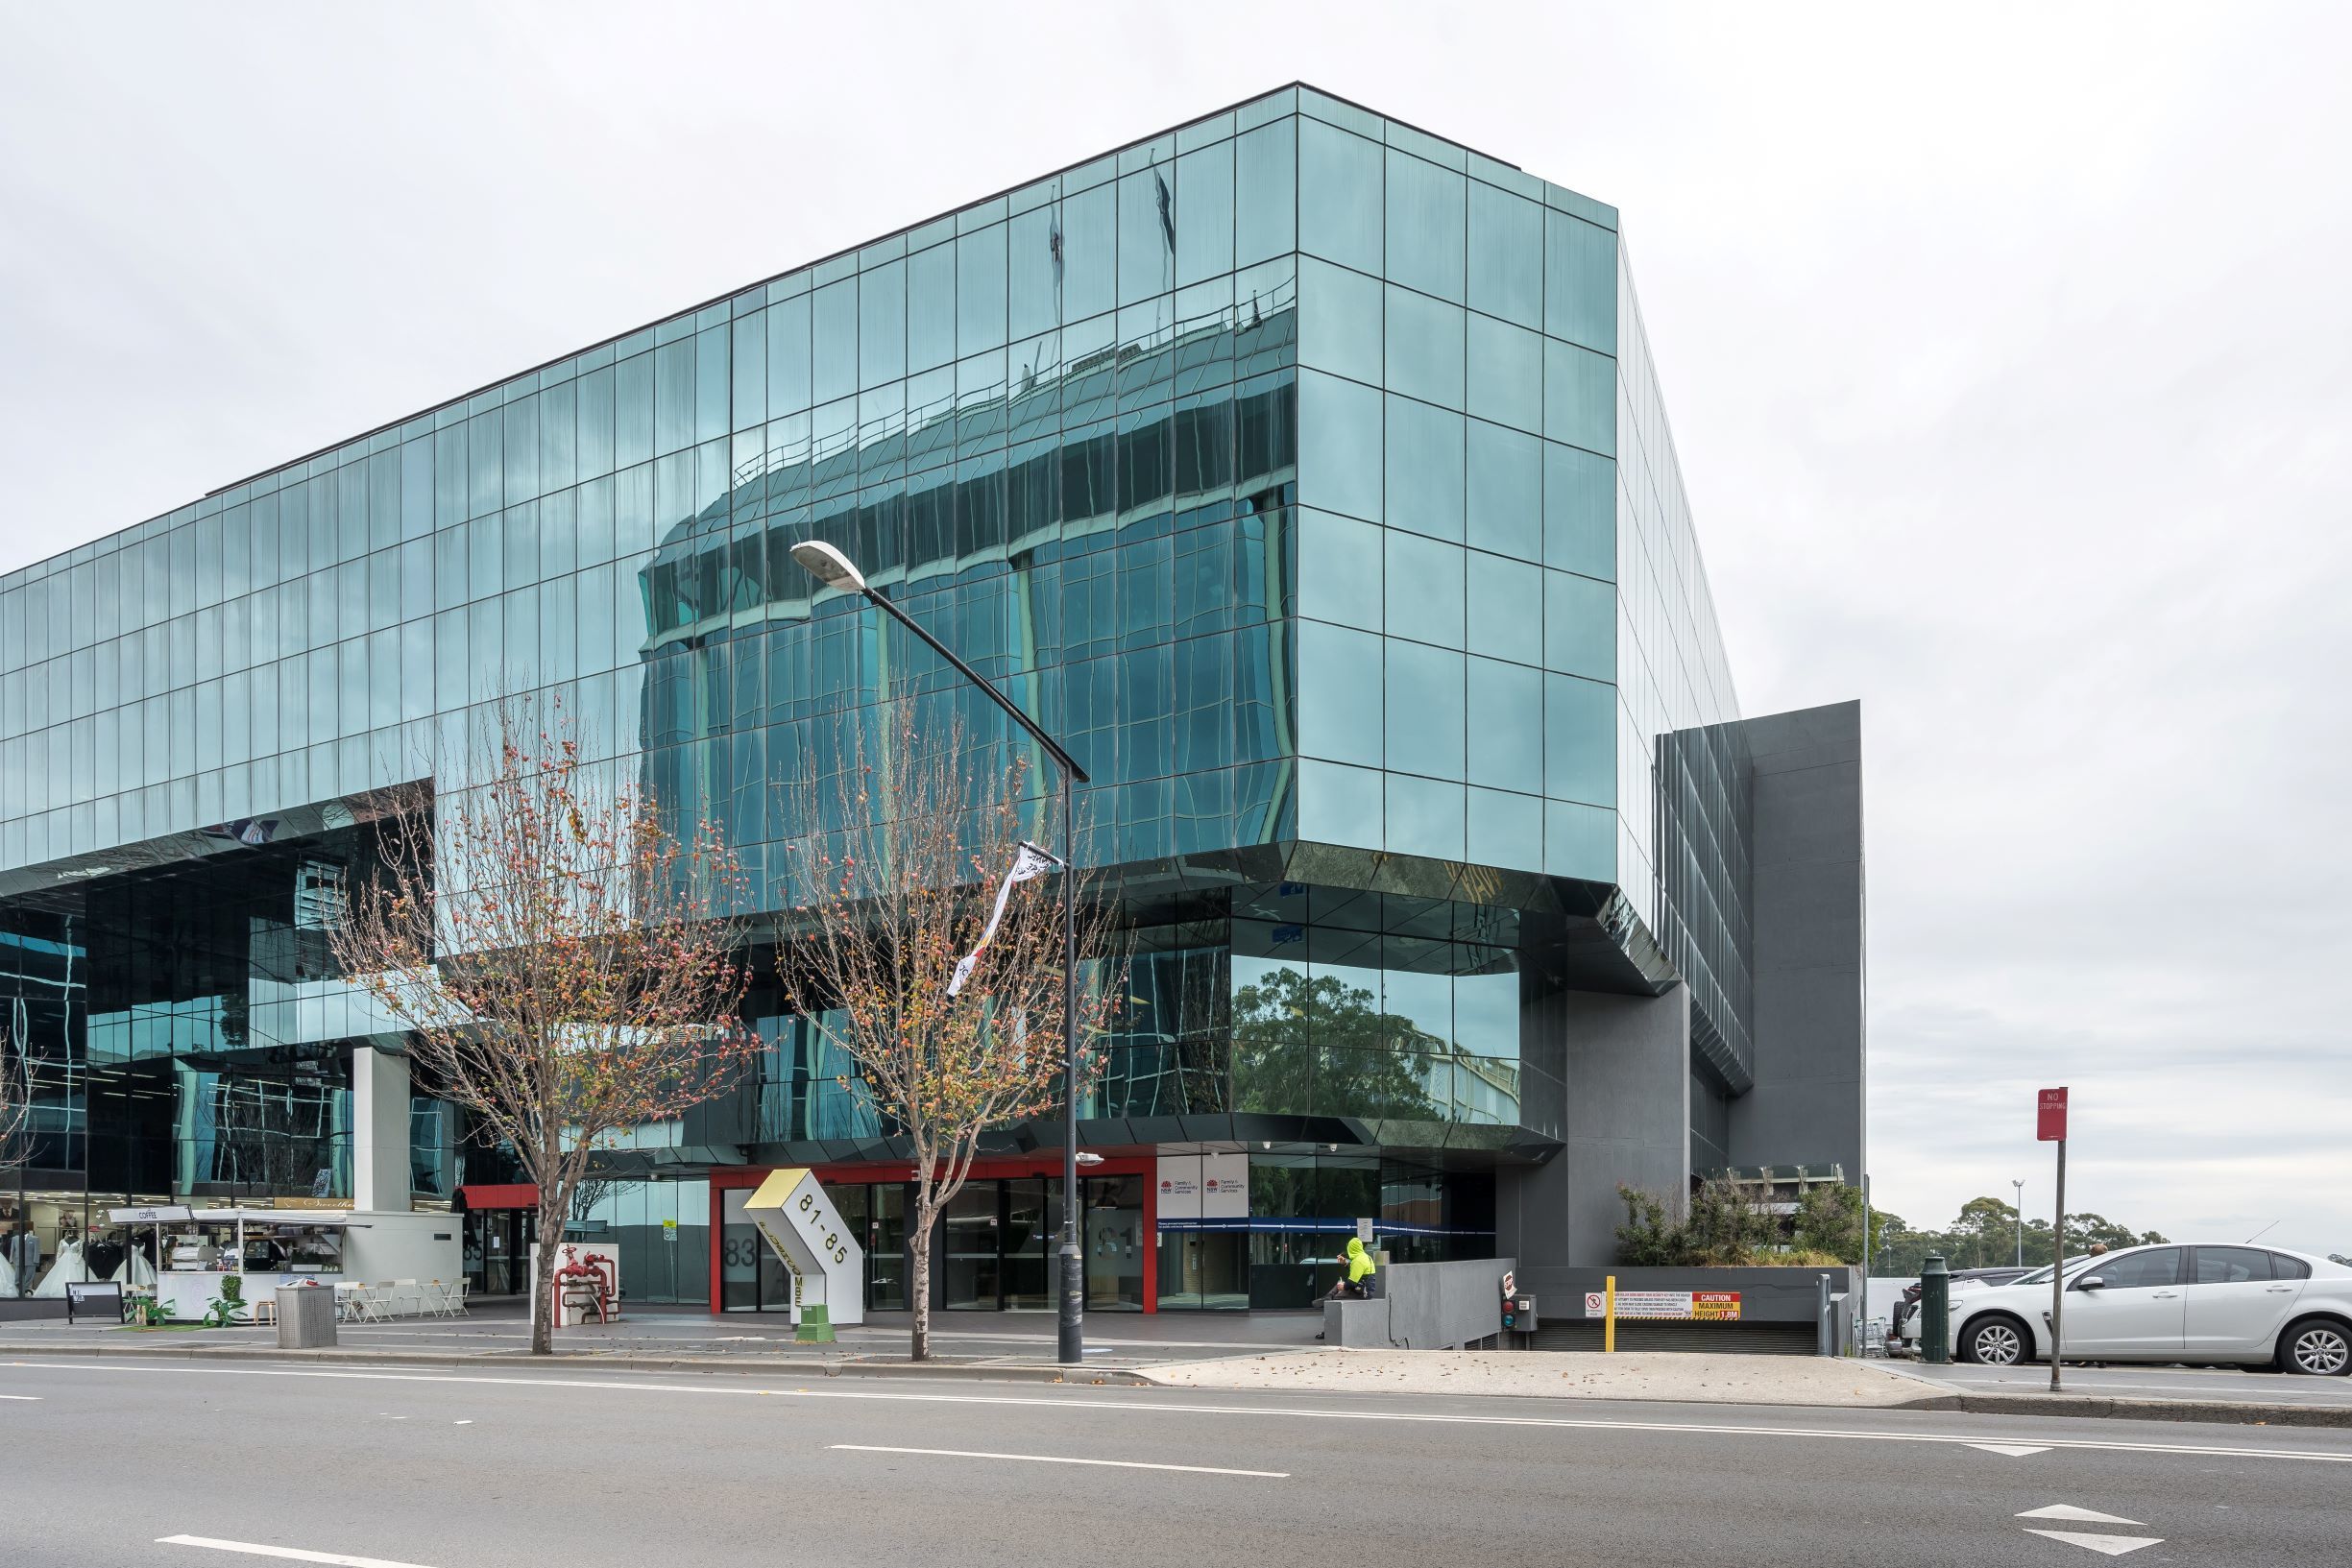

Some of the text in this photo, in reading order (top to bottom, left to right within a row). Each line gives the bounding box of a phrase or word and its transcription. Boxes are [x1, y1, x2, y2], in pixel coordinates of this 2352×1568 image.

[138, 1211, 158, 1219] COFFEE
[799, 1194, 848, 1264] 81-85
[725, 1238, 756, 1267] 83
[1701, 1293, 1732, 1302] CAUTION
